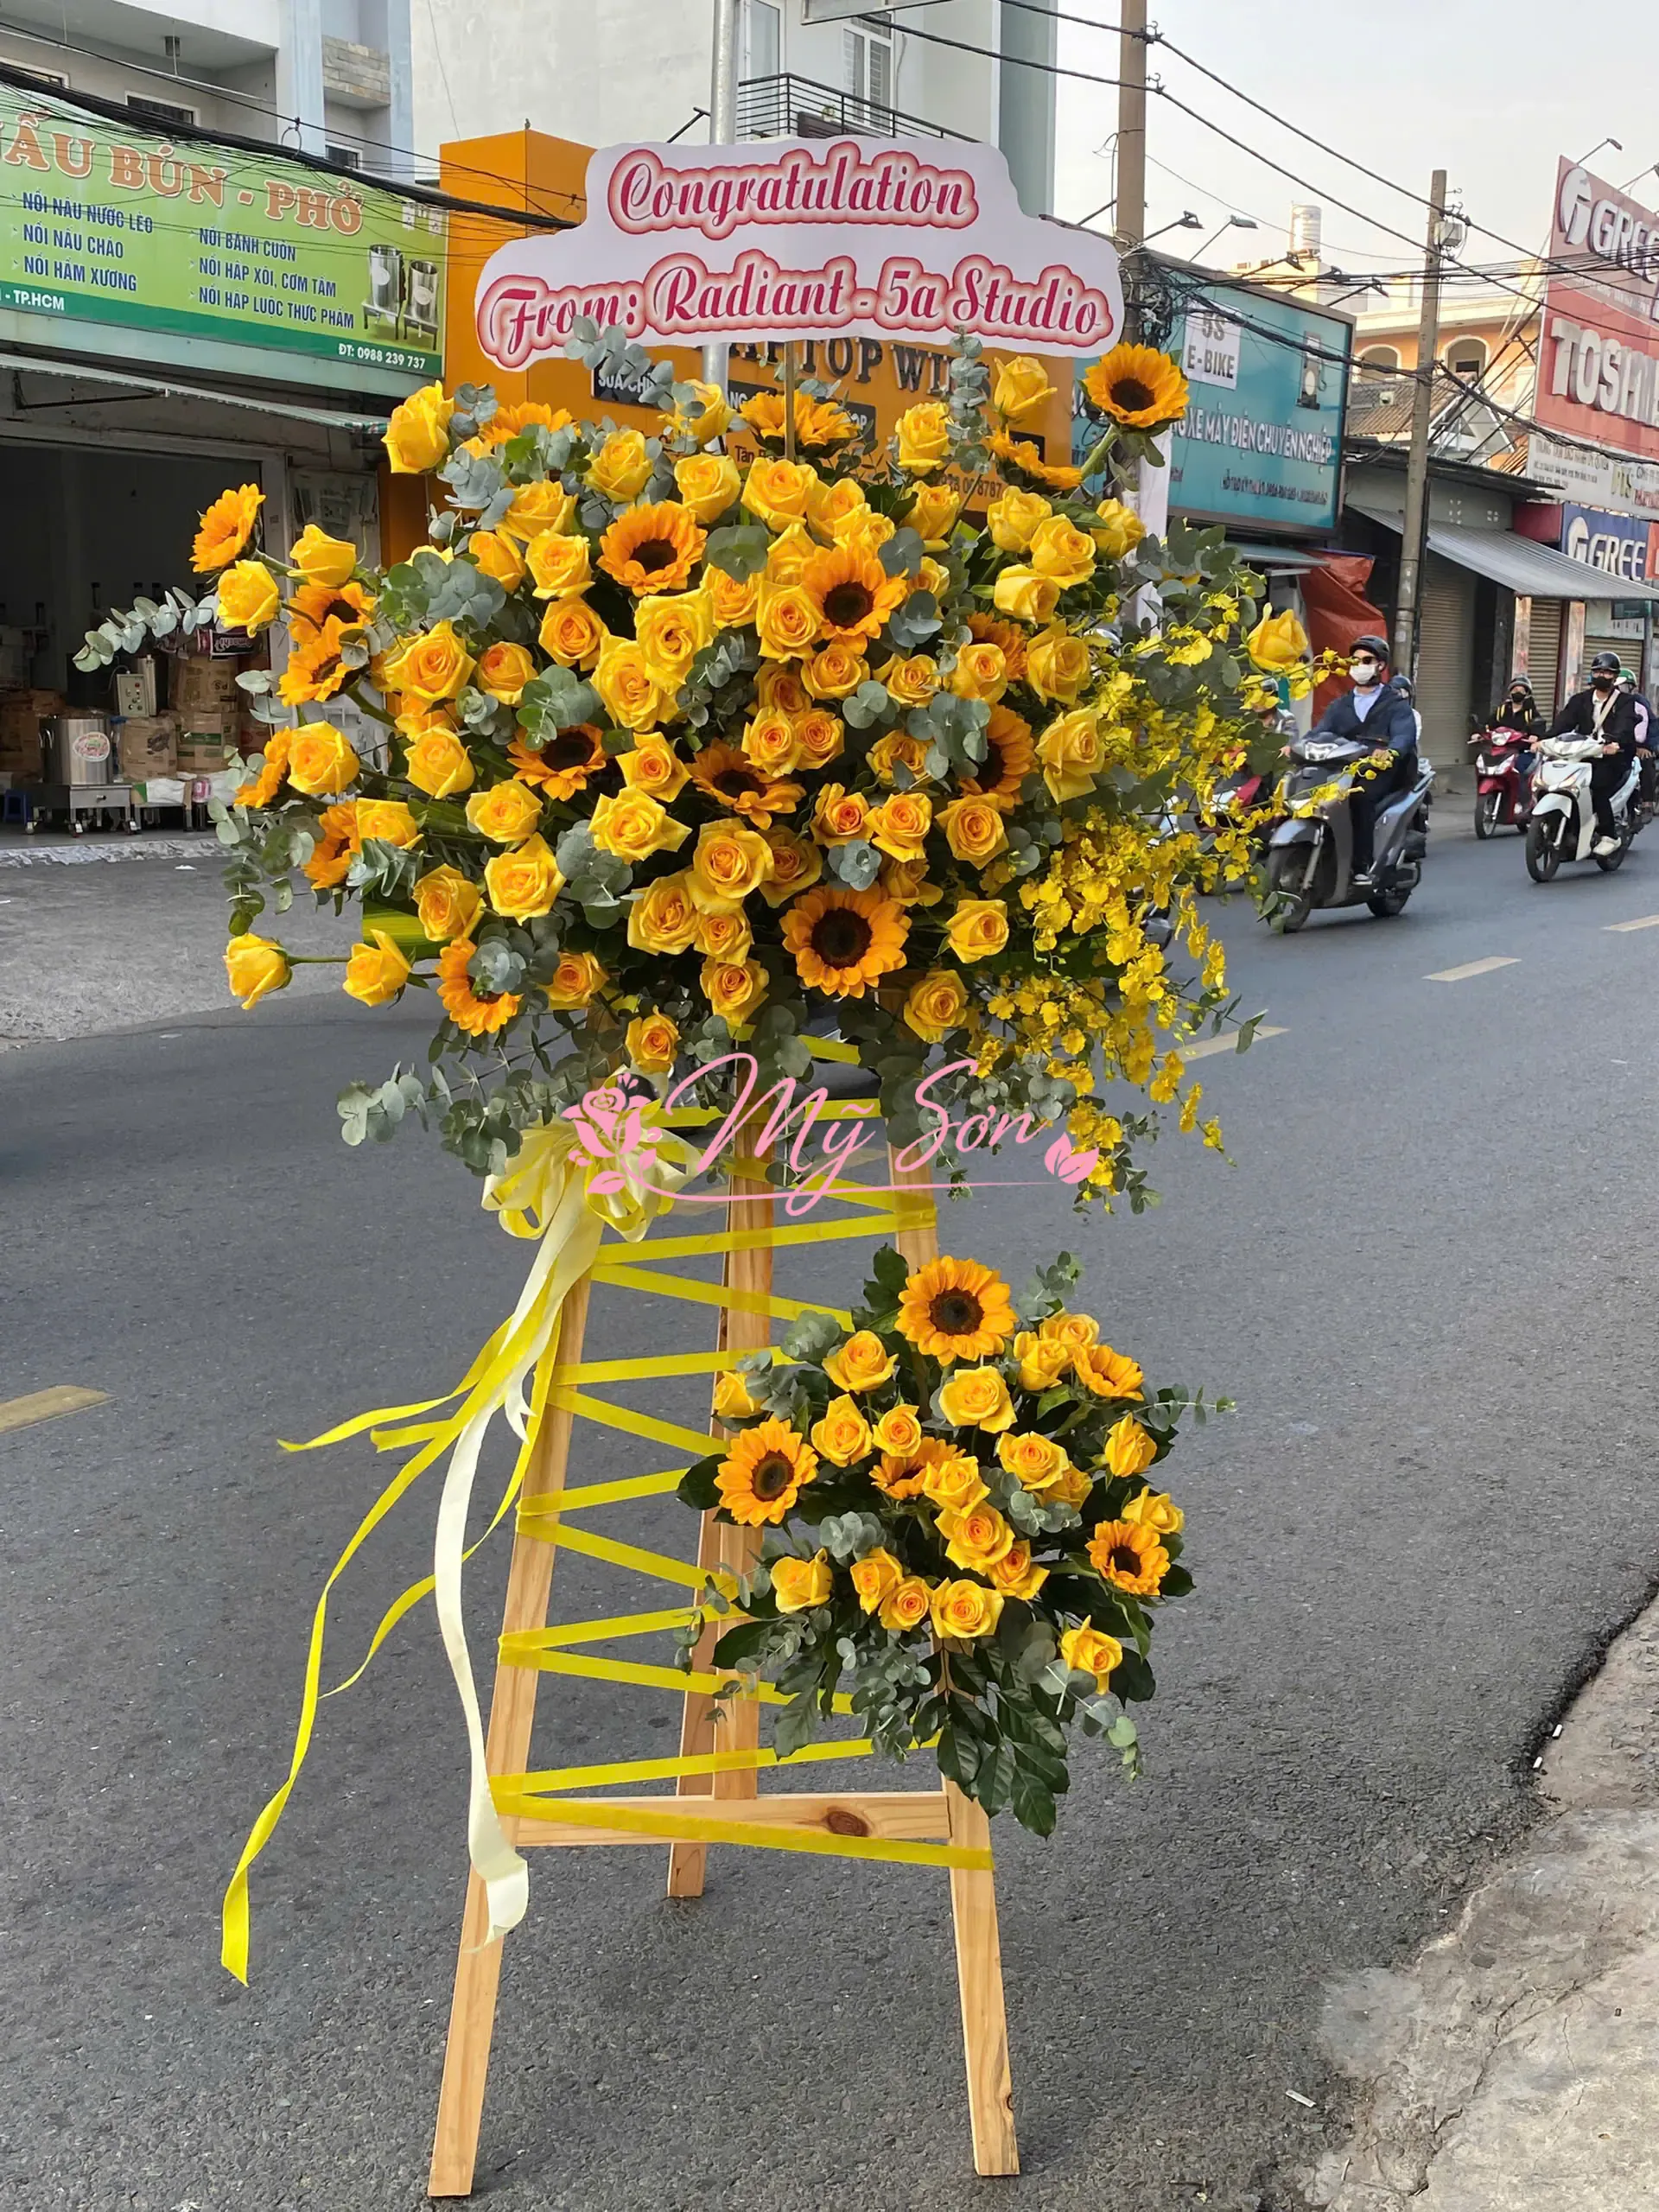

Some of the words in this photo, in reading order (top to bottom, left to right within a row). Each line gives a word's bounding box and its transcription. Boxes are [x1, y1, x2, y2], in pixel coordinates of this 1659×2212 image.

[109, 145, 227, 207] BÚN
[618, 151, 969, 226] Congratulation
[14, 289, 65, 311] TP.HCM
[487, 285, 639, 358] From:
[652, 258, 849, 325] Radiant
[881, 267, 943, 321] 5a
[952, 260, 1103, 336] Studio
[339, 342, 355, 357] ĐT:
[357, 346, 383, 362] 0988
[385, 351, 404, 366] 239
[407, 355, 426, 370] 737
[1188, 407, 1204, 440] XE
[1588, 533, 1646, 582] GREE
